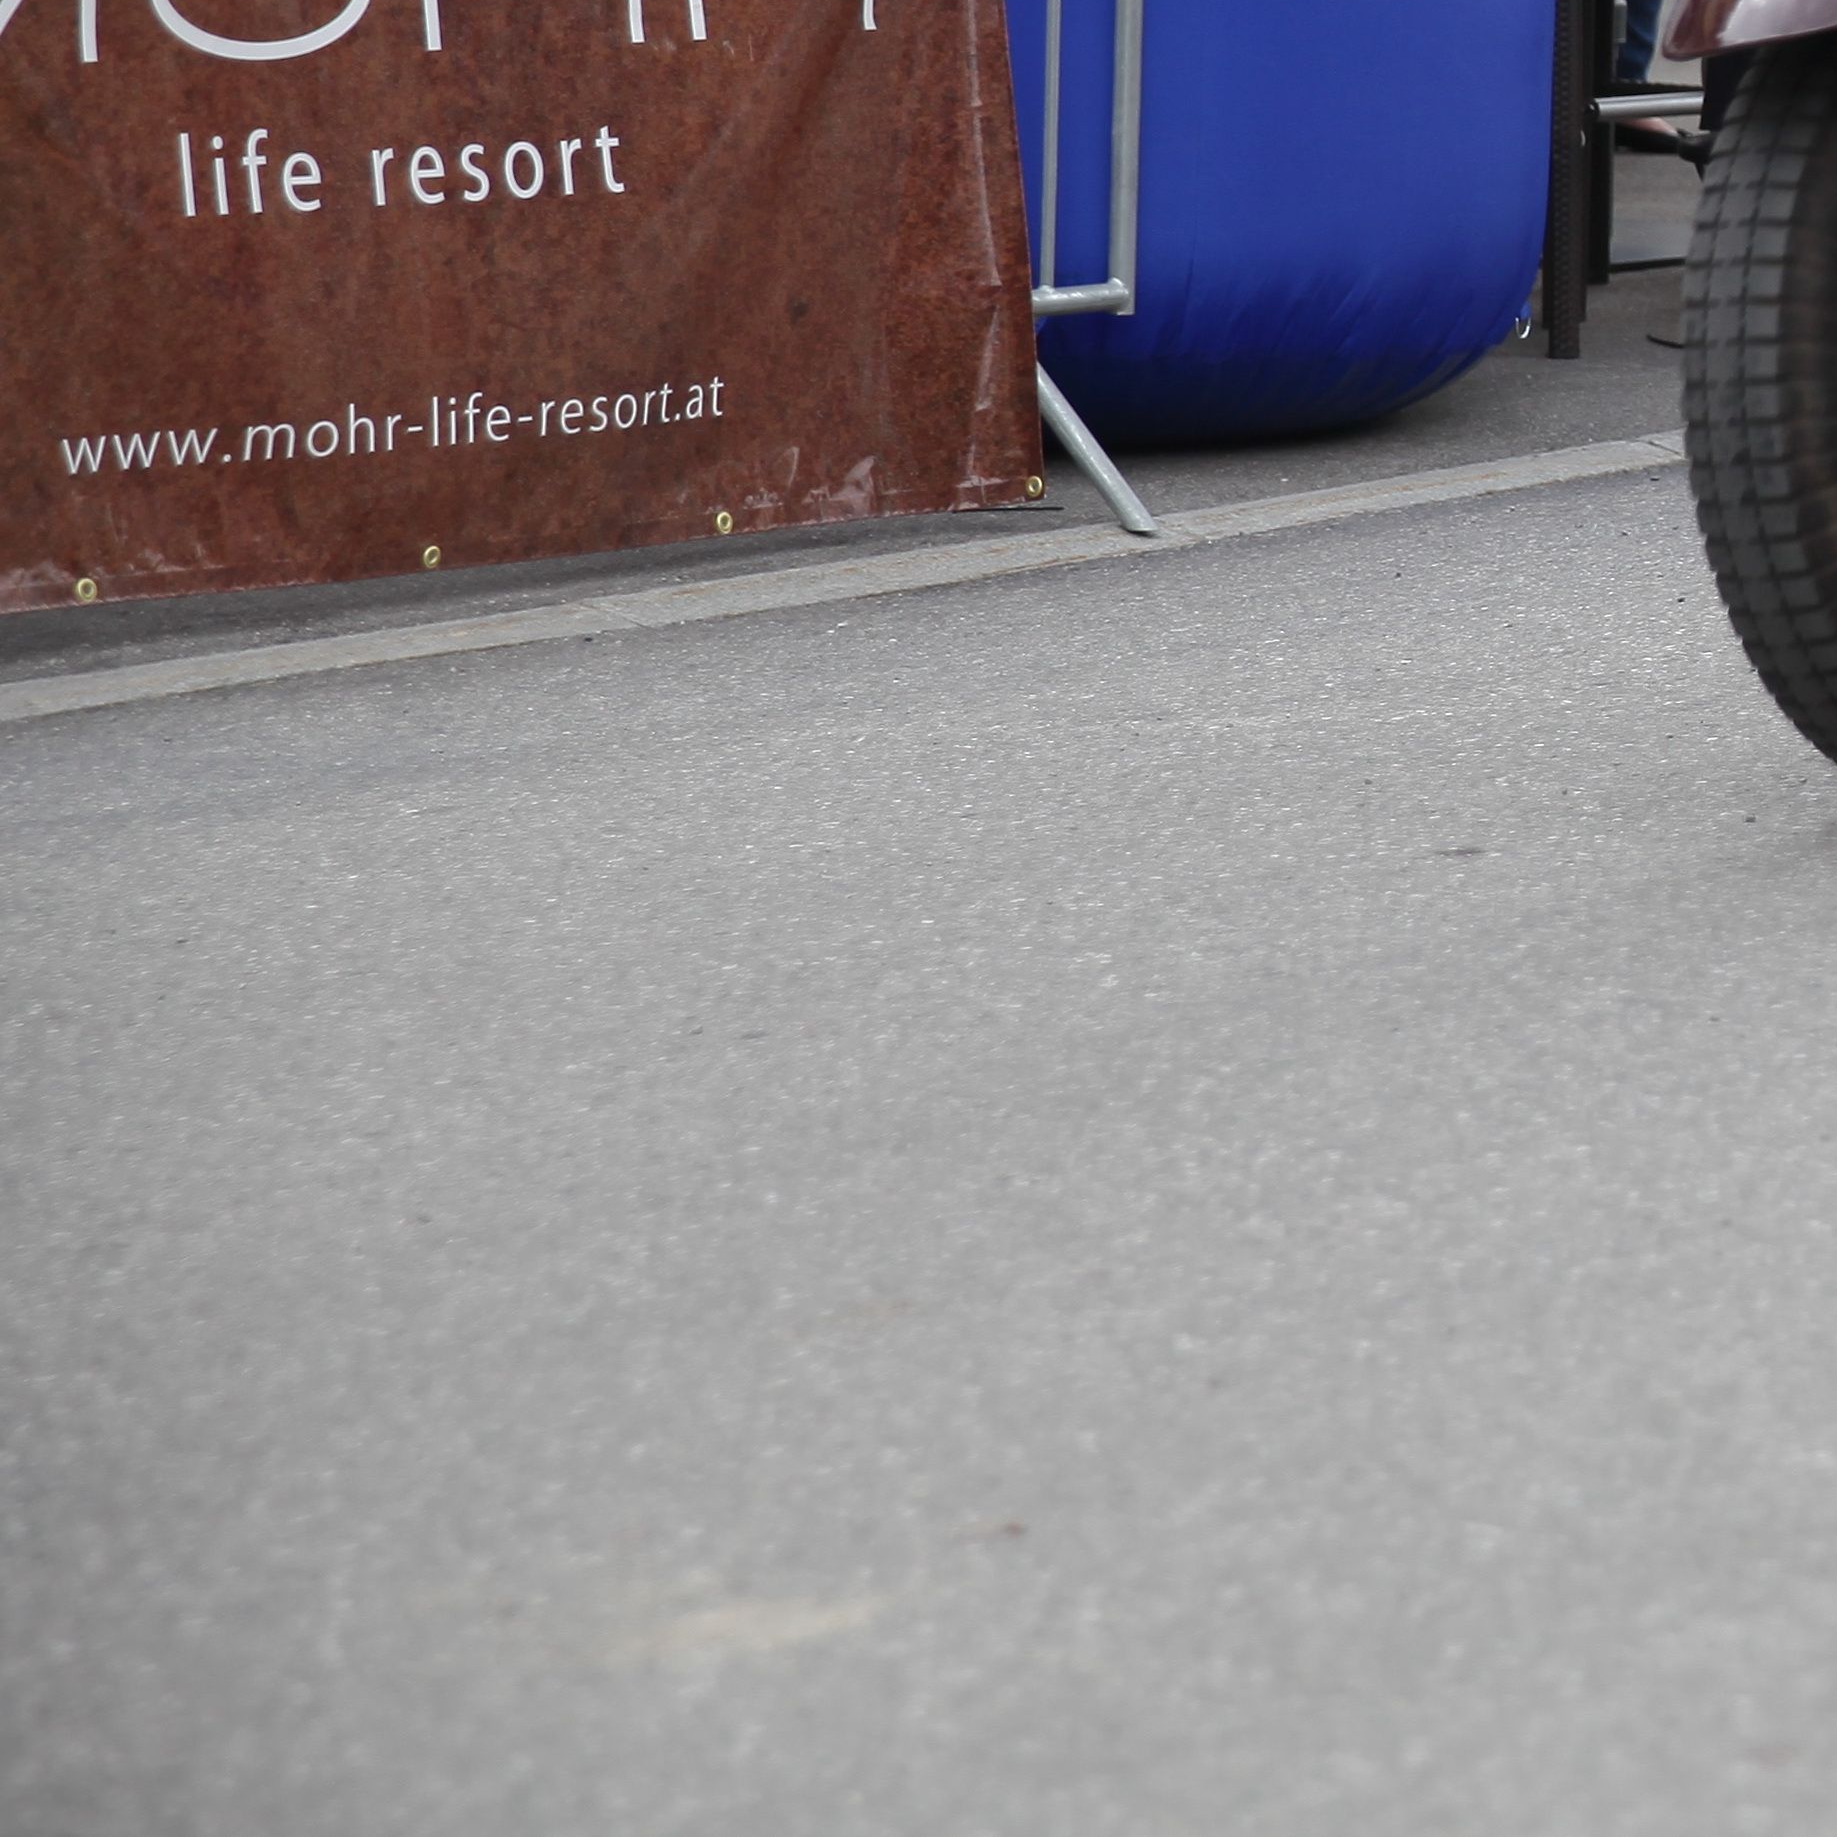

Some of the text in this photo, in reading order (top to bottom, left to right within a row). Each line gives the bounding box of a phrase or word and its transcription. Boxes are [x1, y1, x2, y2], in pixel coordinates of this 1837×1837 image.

[179, 124, 626, 217] life resort
[61, 375, 726, 476] www.mohr-life-resort.at
